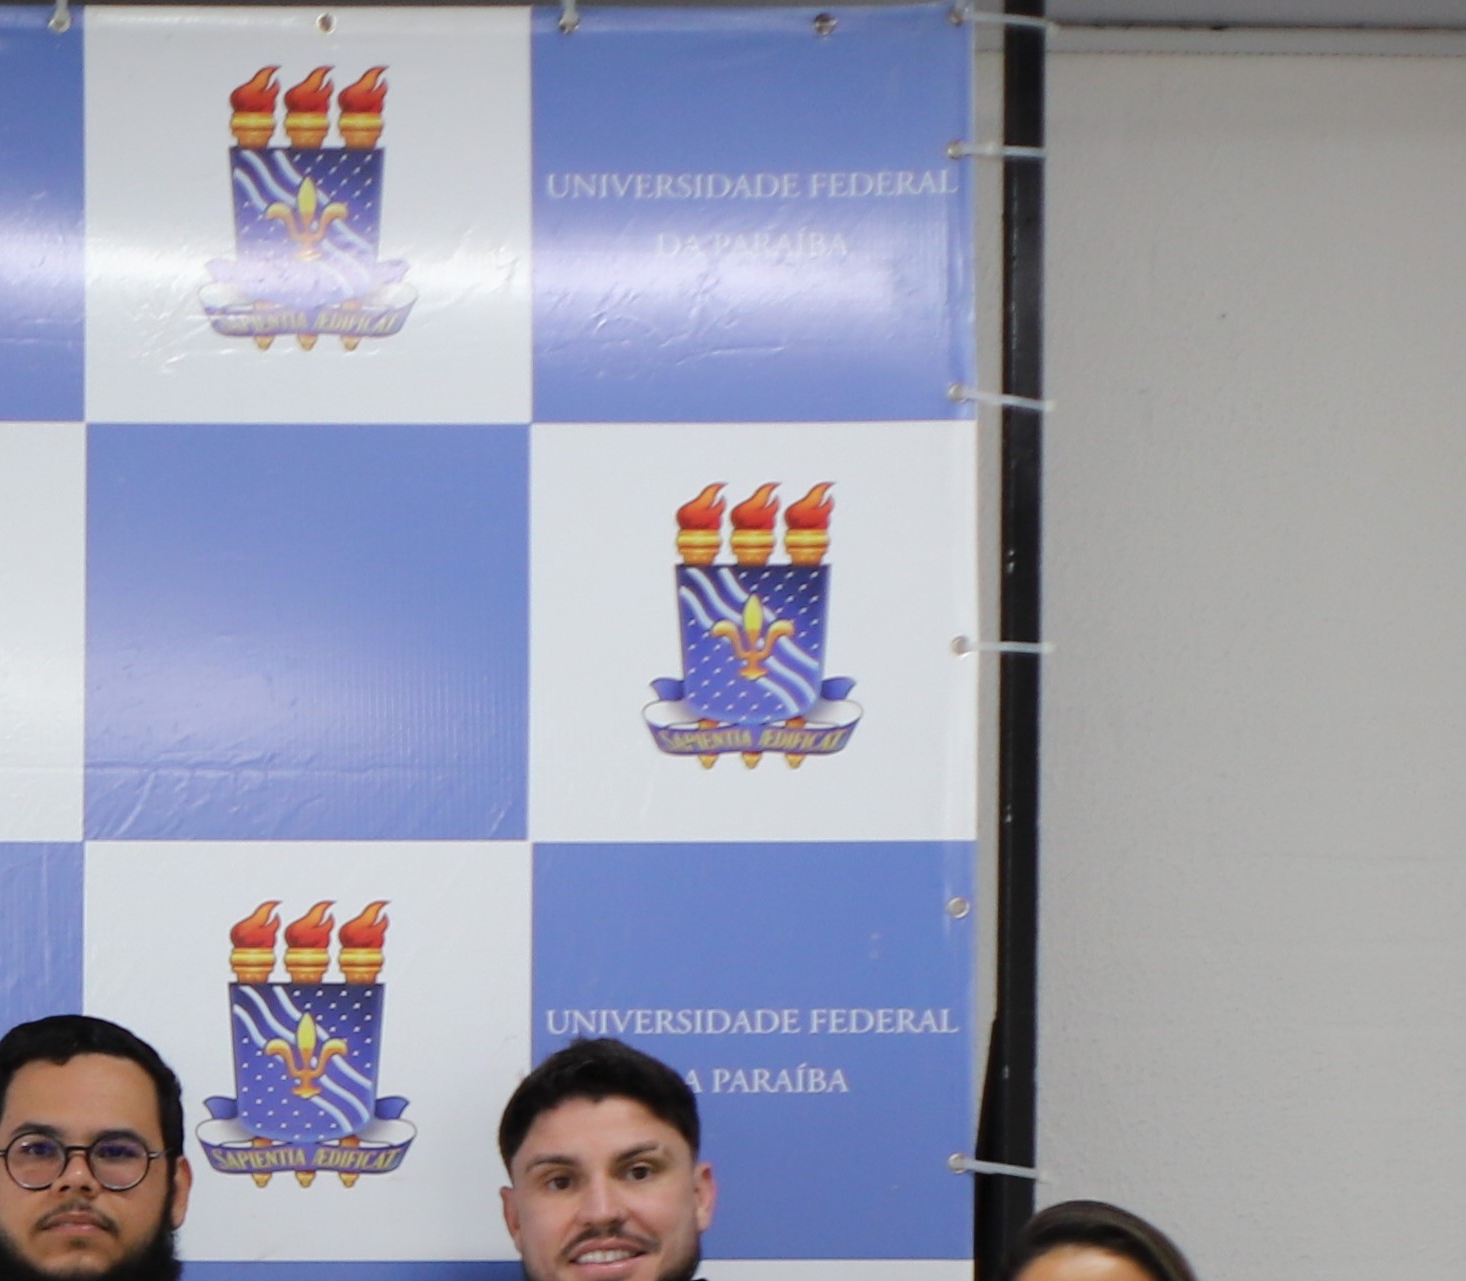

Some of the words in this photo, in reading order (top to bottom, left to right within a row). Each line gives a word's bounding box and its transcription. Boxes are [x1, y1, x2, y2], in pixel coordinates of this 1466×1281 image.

[547, 172, 800, 200] UNIVERSIDADE
[809, 171, 959, 199] FEDERAL
[657, 231, 706, 258] DA
[716, 227, 848, 258] PARAÍBA
[546, 1009, 800, 1034] UNIVERSIDADE
[810, 1009, 959, 1034] FEDERAL
[713, 1063, 848, 1092] PARAÍBA
[212, 1148, 306, 1171] SAPIENTIA
[311, 1148, 399, 1171] ÆDIFICAT
